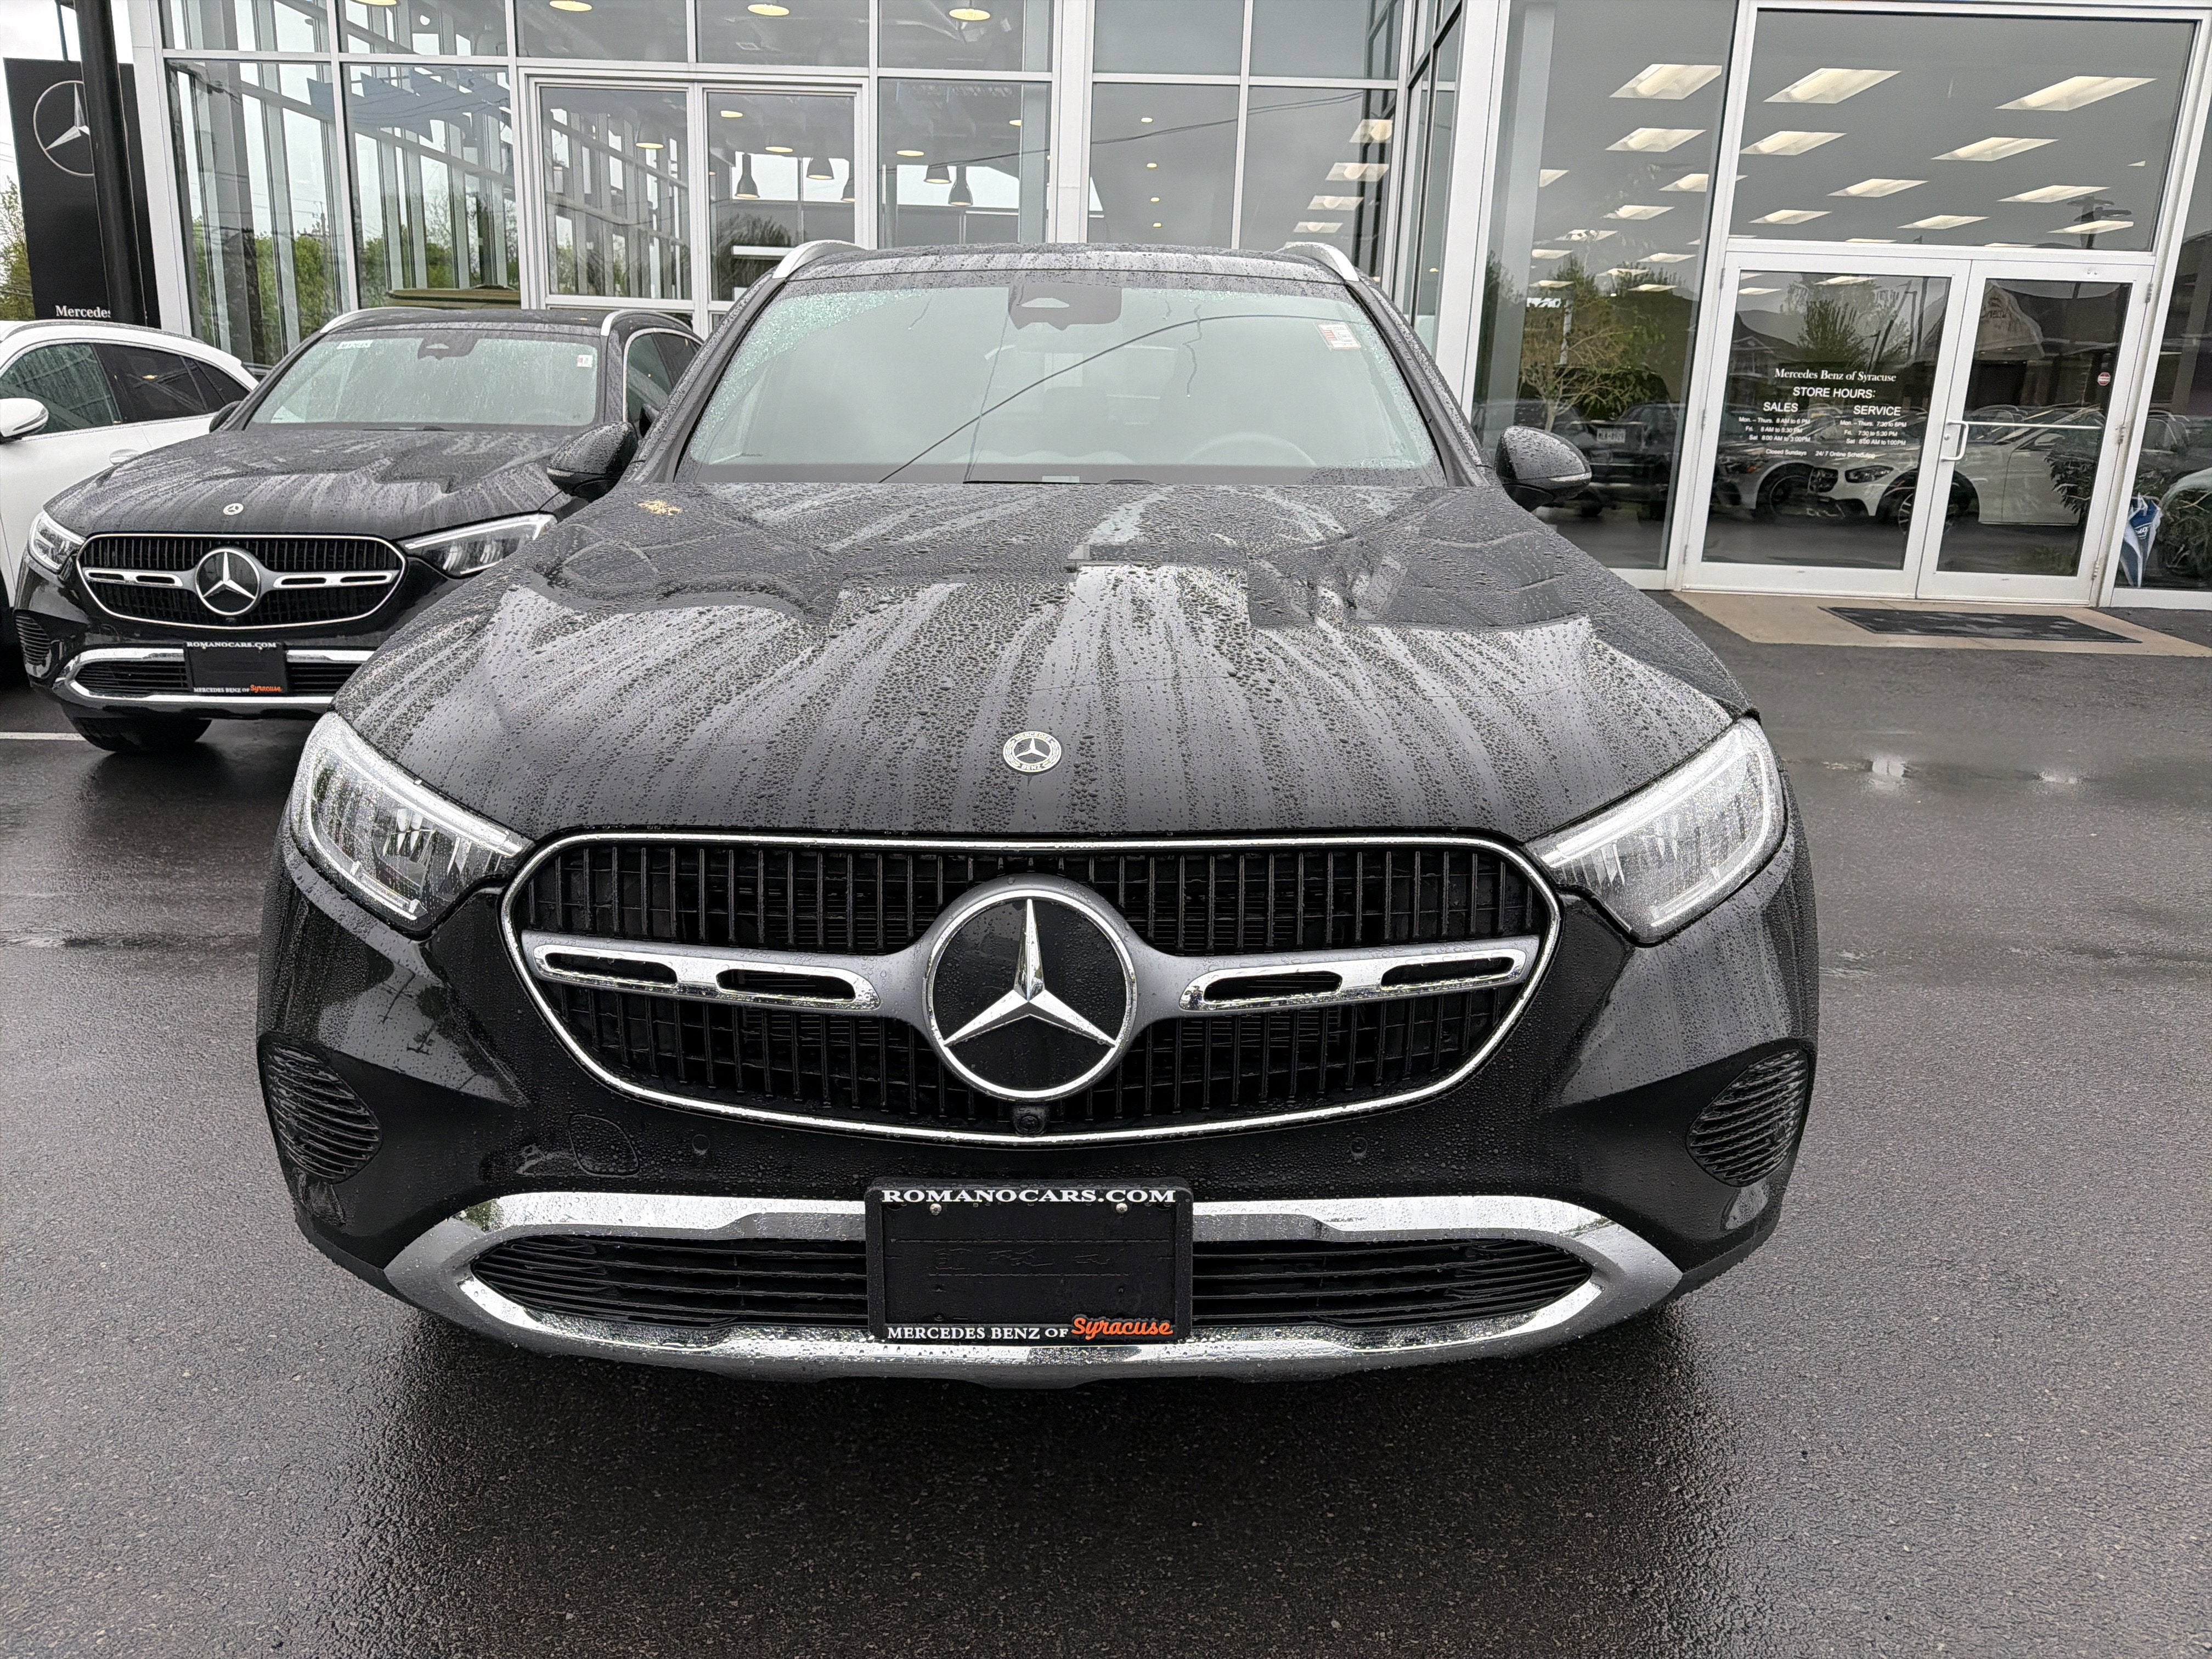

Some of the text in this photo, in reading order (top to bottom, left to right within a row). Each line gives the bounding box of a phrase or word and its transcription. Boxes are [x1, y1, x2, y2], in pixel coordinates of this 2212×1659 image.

[1774, 368, 1897, 382] Mercedes Benz of Syracuse
[1793, 387, 1876, 399] STORE HOURS:
[1763, 402, 1798, 412] SALES
[1853, 405, 1901, 416] SERVICE
[250, 685, 281, 693] Syracuse
[882, 1189, 1176, 1203] ROMANOCARS.COM
[887, 1317, 1173, 1340] MERCEDES BENZ OF Syracuse
